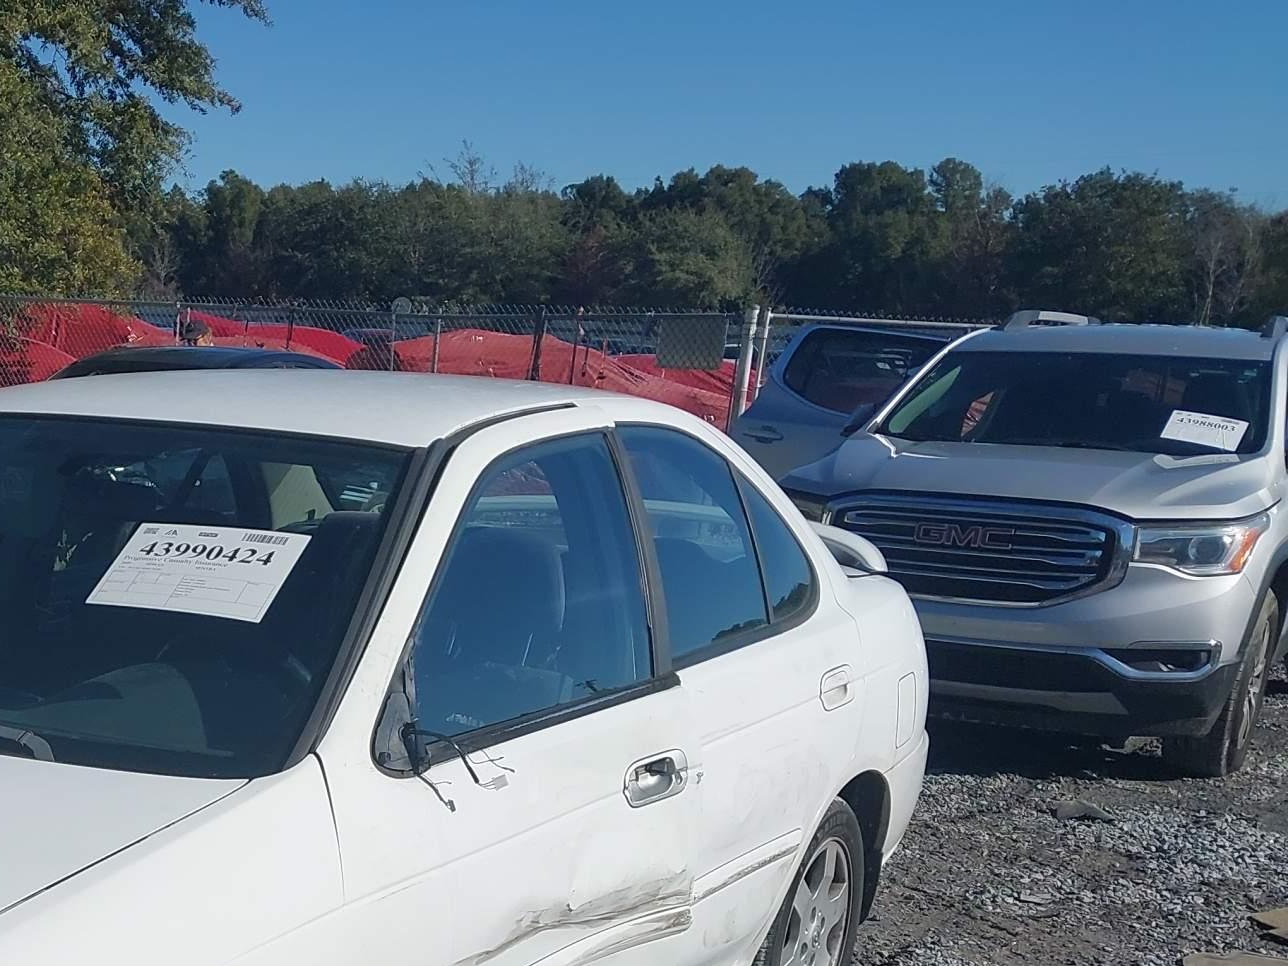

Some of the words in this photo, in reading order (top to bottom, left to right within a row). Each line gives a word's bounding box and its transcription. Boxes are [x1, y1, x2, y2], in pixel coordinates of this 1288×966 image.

[1175, 417, 1237, 433] 43988003
[913, 521, 1017, 550] GMC
[139, 541, 278, 567] 43990424
